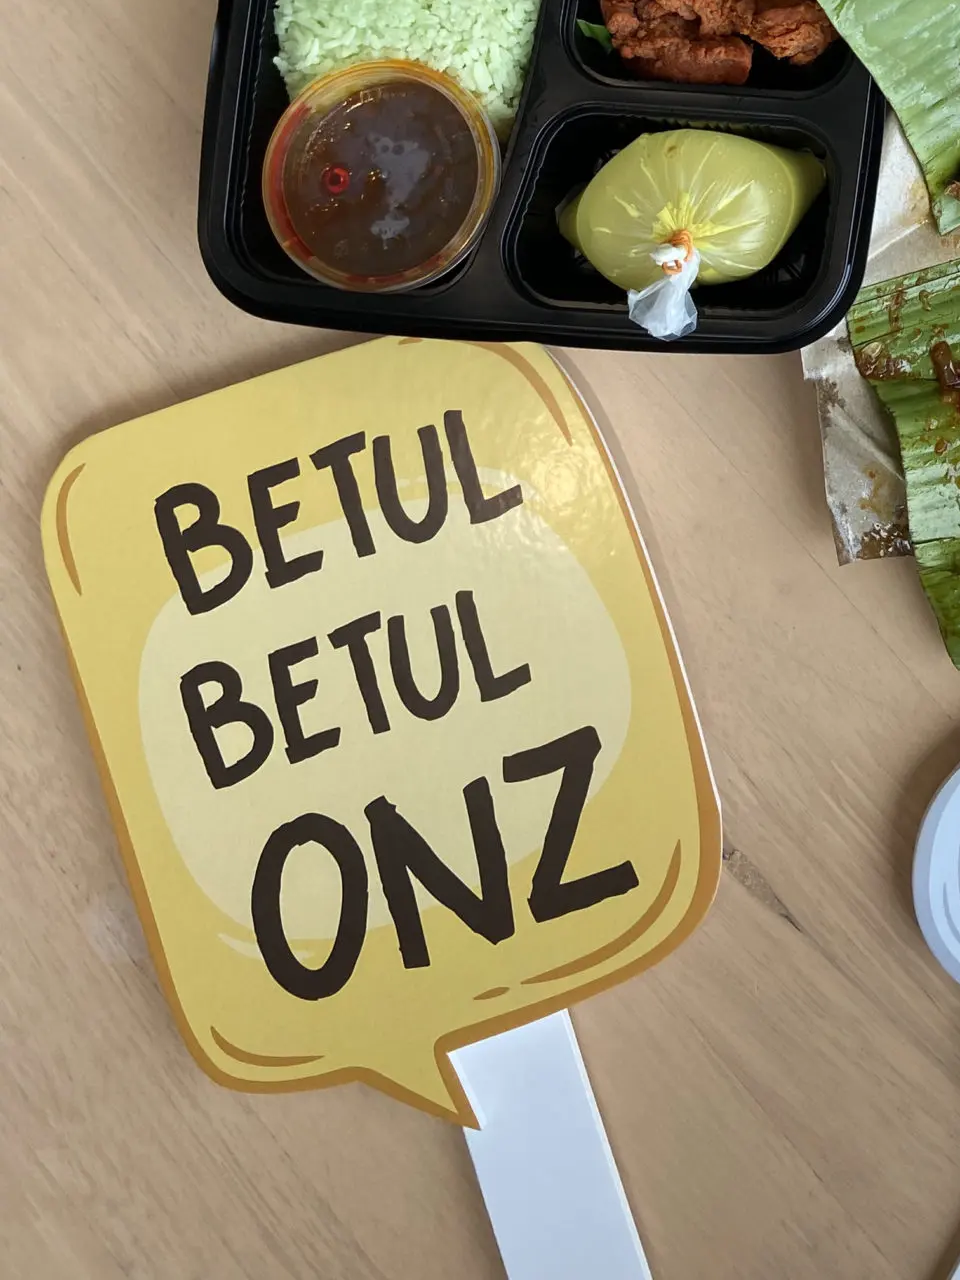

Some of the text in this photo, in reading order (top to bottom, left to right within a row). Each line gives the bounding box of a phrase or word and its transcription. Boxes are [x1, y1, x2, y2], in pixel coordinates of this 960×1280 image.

[154, 410, 523, 615] BETUL
[180, 590, 531, 789] BETUL
[251, 725, 639, 1001] ONZ
